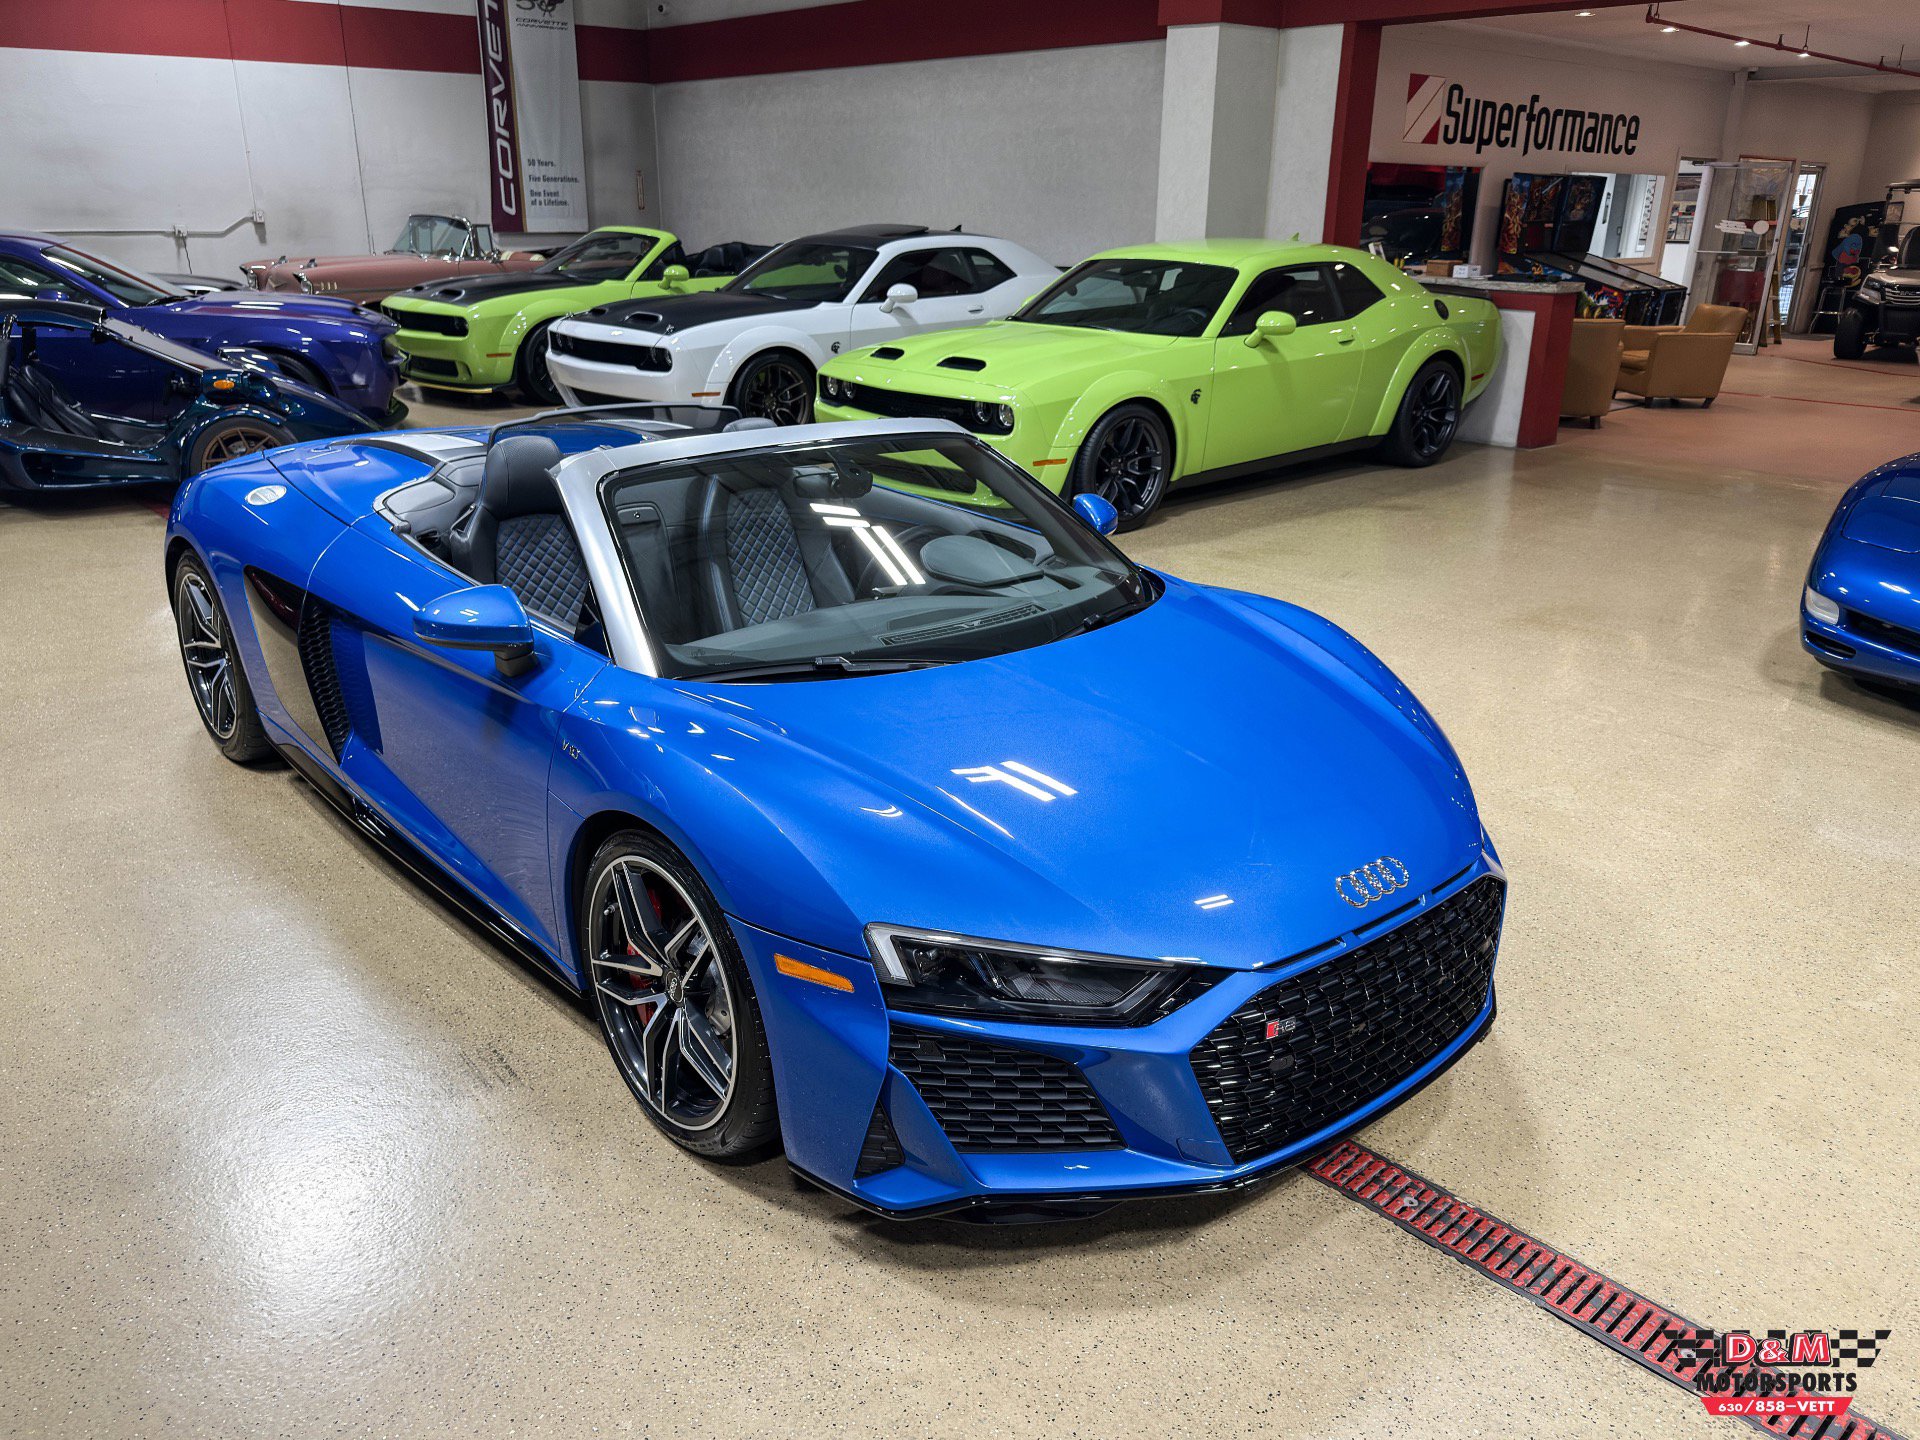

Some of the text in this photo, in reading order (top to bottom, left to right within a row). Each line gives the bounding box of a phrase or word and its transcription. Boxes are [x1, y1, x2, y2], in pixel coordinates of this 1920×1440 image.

[1443, 83, 1640, 157] Superformance
[527, 158, 557, 167] 50 Years.
[528, 175, 580, 184] Five Generations.
[529, 189, 560, 198] One Event
[530, 199, 538, 207] of
[544, 199, 570, 207] Lifetime.
